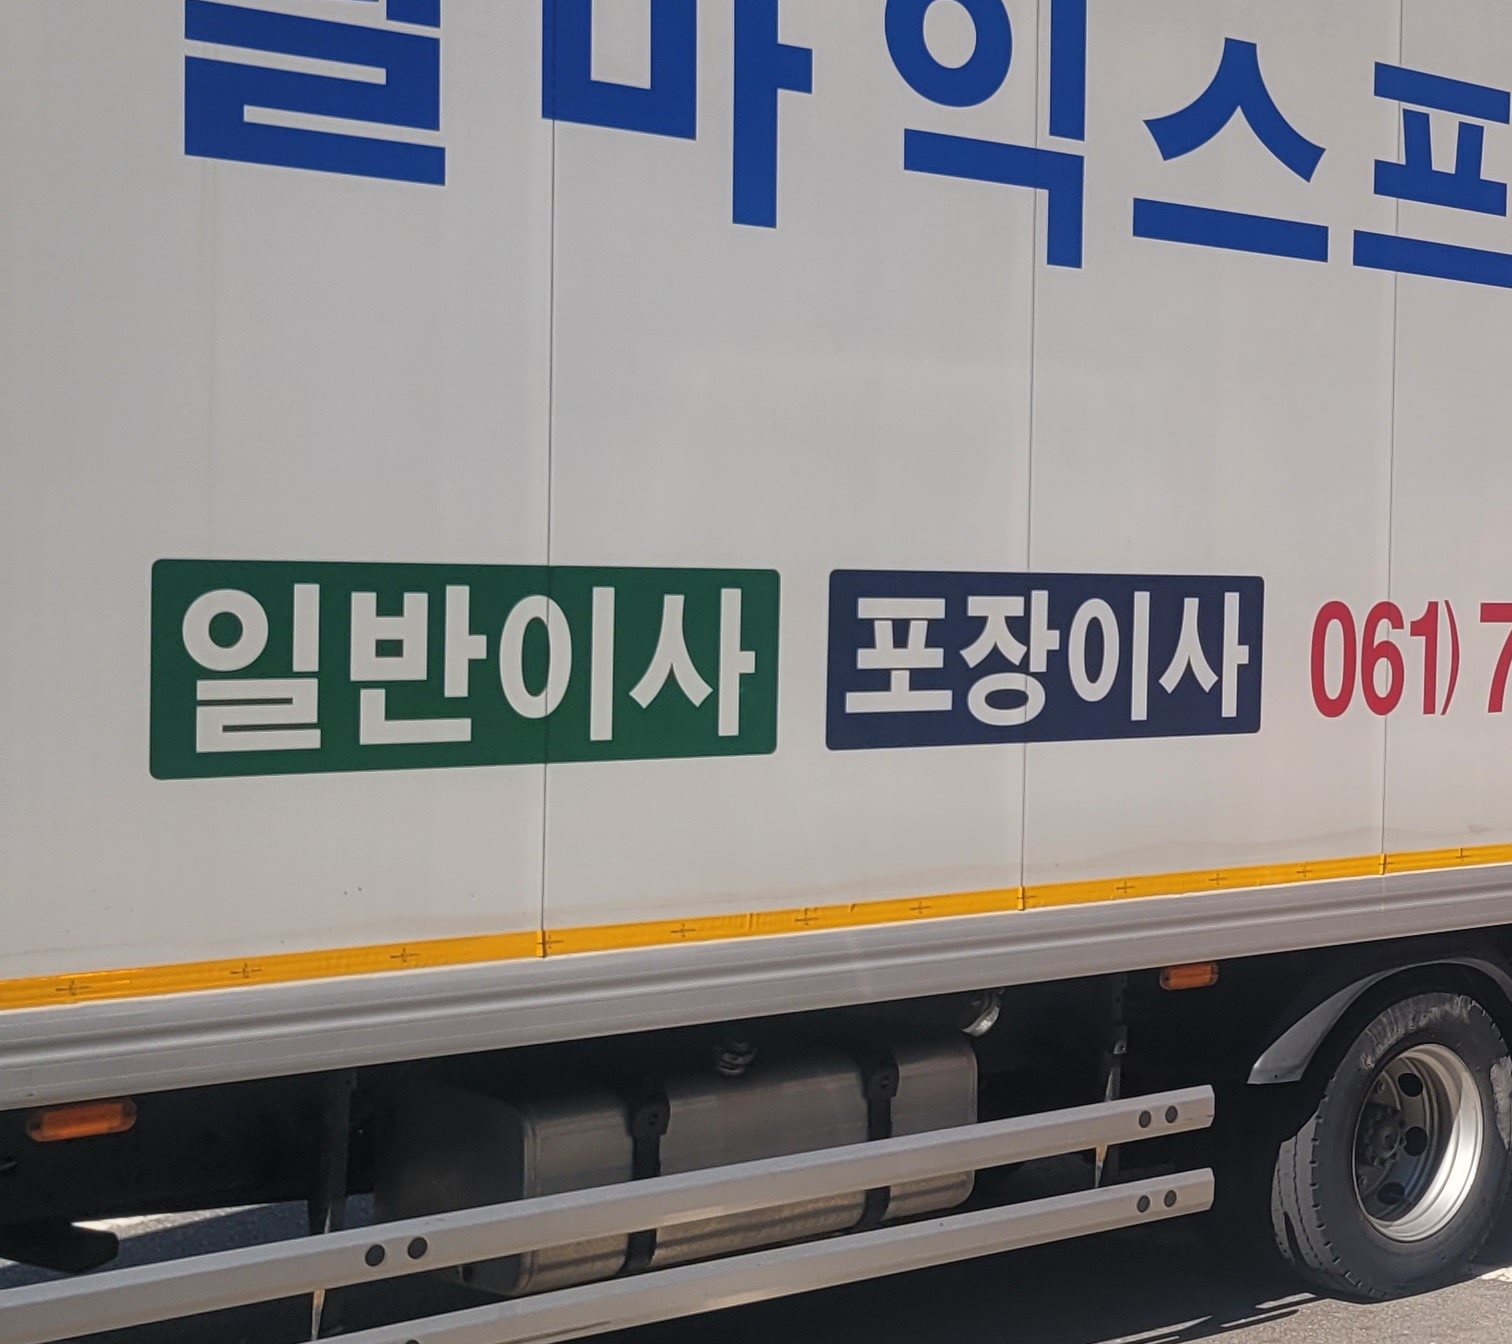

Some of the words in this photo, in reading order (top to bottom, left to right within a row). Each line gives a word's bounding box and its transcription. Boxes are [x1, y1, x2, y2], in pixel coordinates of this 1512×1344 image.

[182, 582, 756, 753] 일반이사
[844, 590, 1250, 727] 포장이사
[1309, 600, 1461, 718] 061)
